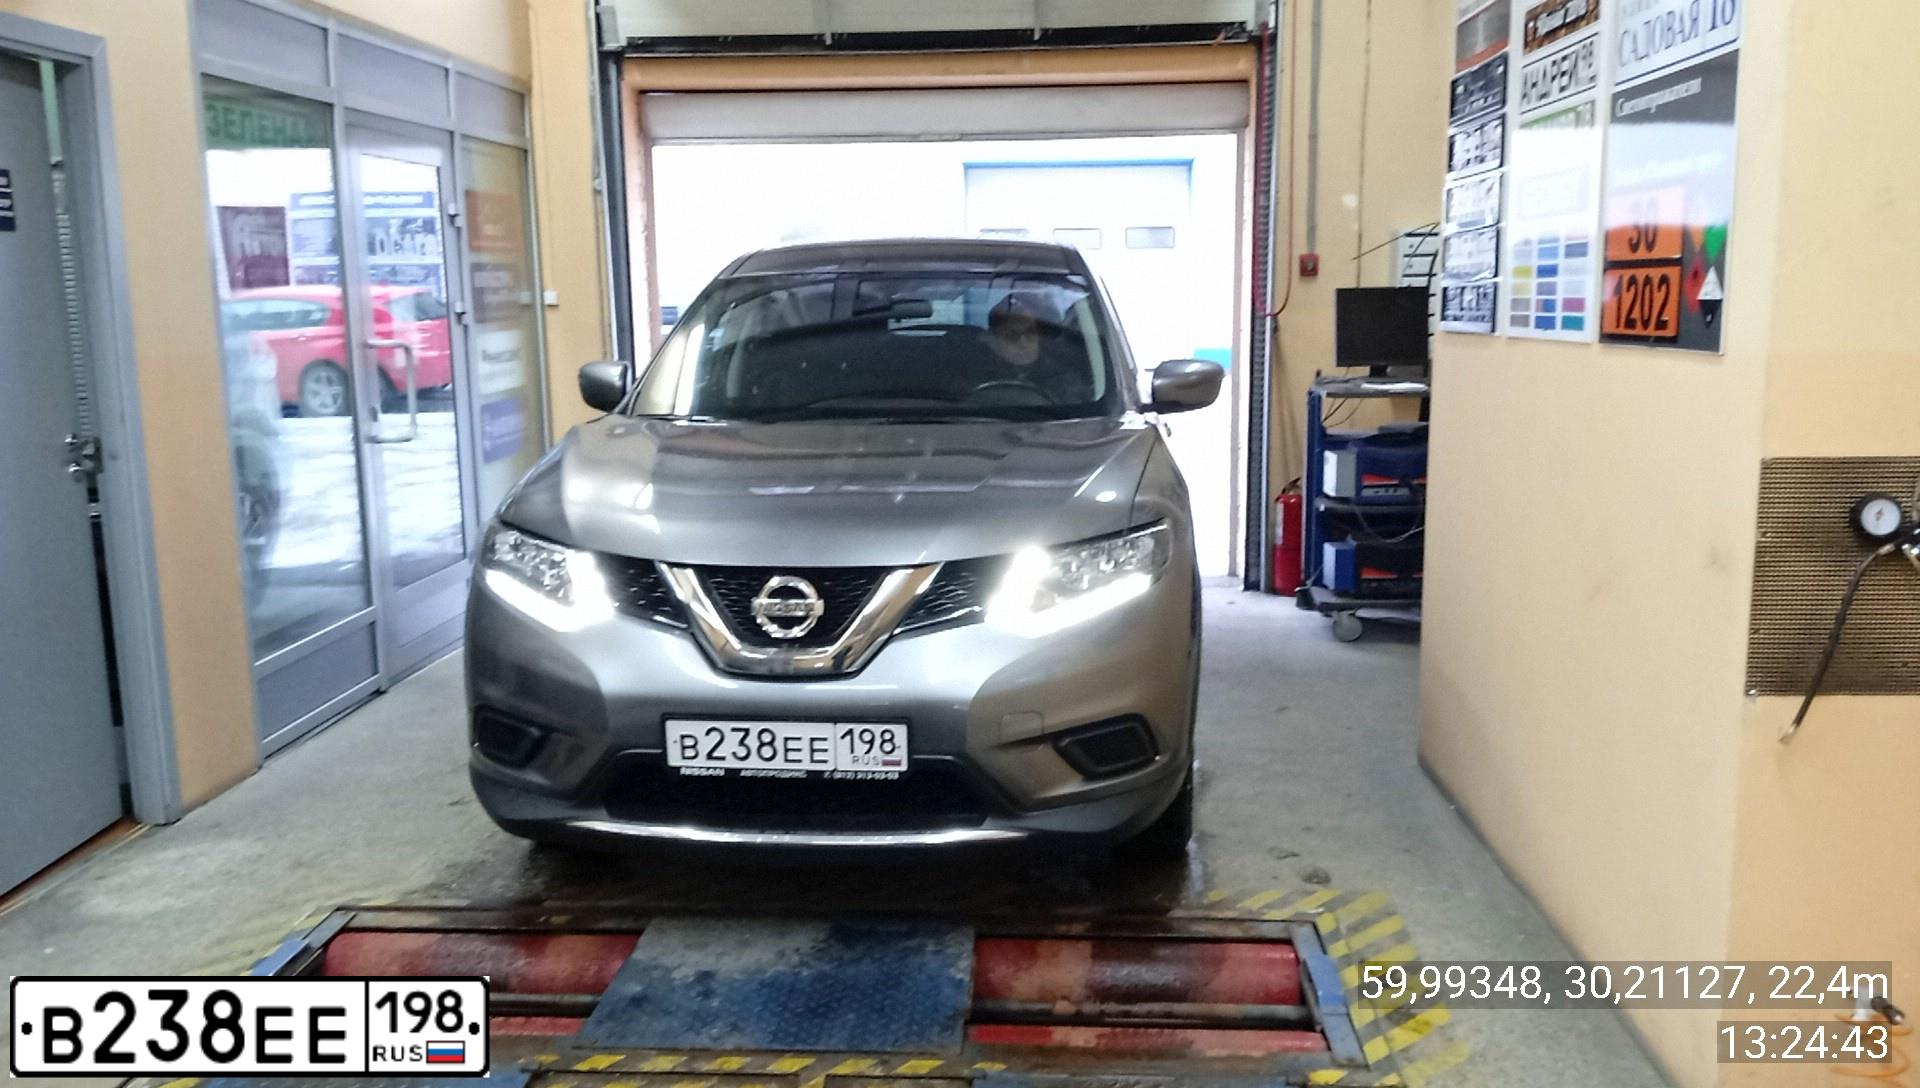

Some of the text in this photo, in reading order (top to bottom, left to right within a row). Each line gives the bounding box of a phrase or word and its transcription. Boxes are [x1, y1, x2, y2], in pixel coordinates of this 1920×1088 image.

[1613, 273, 1671, 332] 1202
[840, 728, 896, 755] 198
[851, 755, 880, 767] RUS
